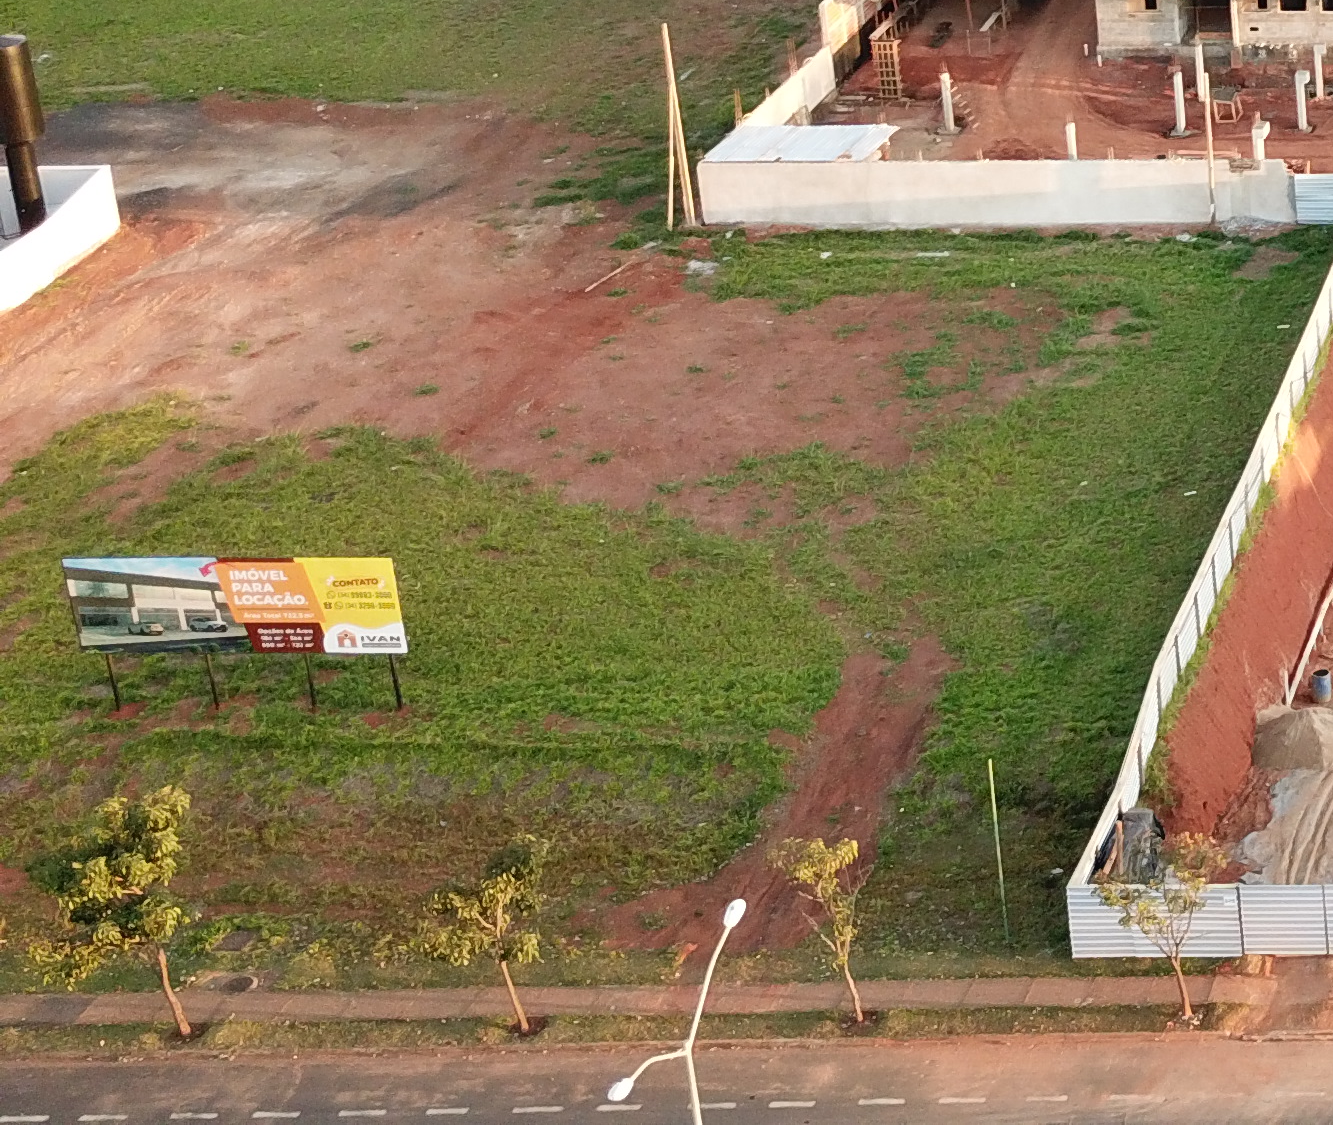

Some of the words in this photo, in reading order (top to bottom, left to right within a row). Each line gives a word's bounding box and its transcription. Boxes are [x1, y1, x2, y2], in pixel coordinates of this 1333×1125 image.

[229, 568, 288, 581] IMÓVEL
[231, 582, 275, 593] PARA
[332, 577, 379, 588] CONTATO
[233, 592, 309, 607] LOCAÇÃO.
